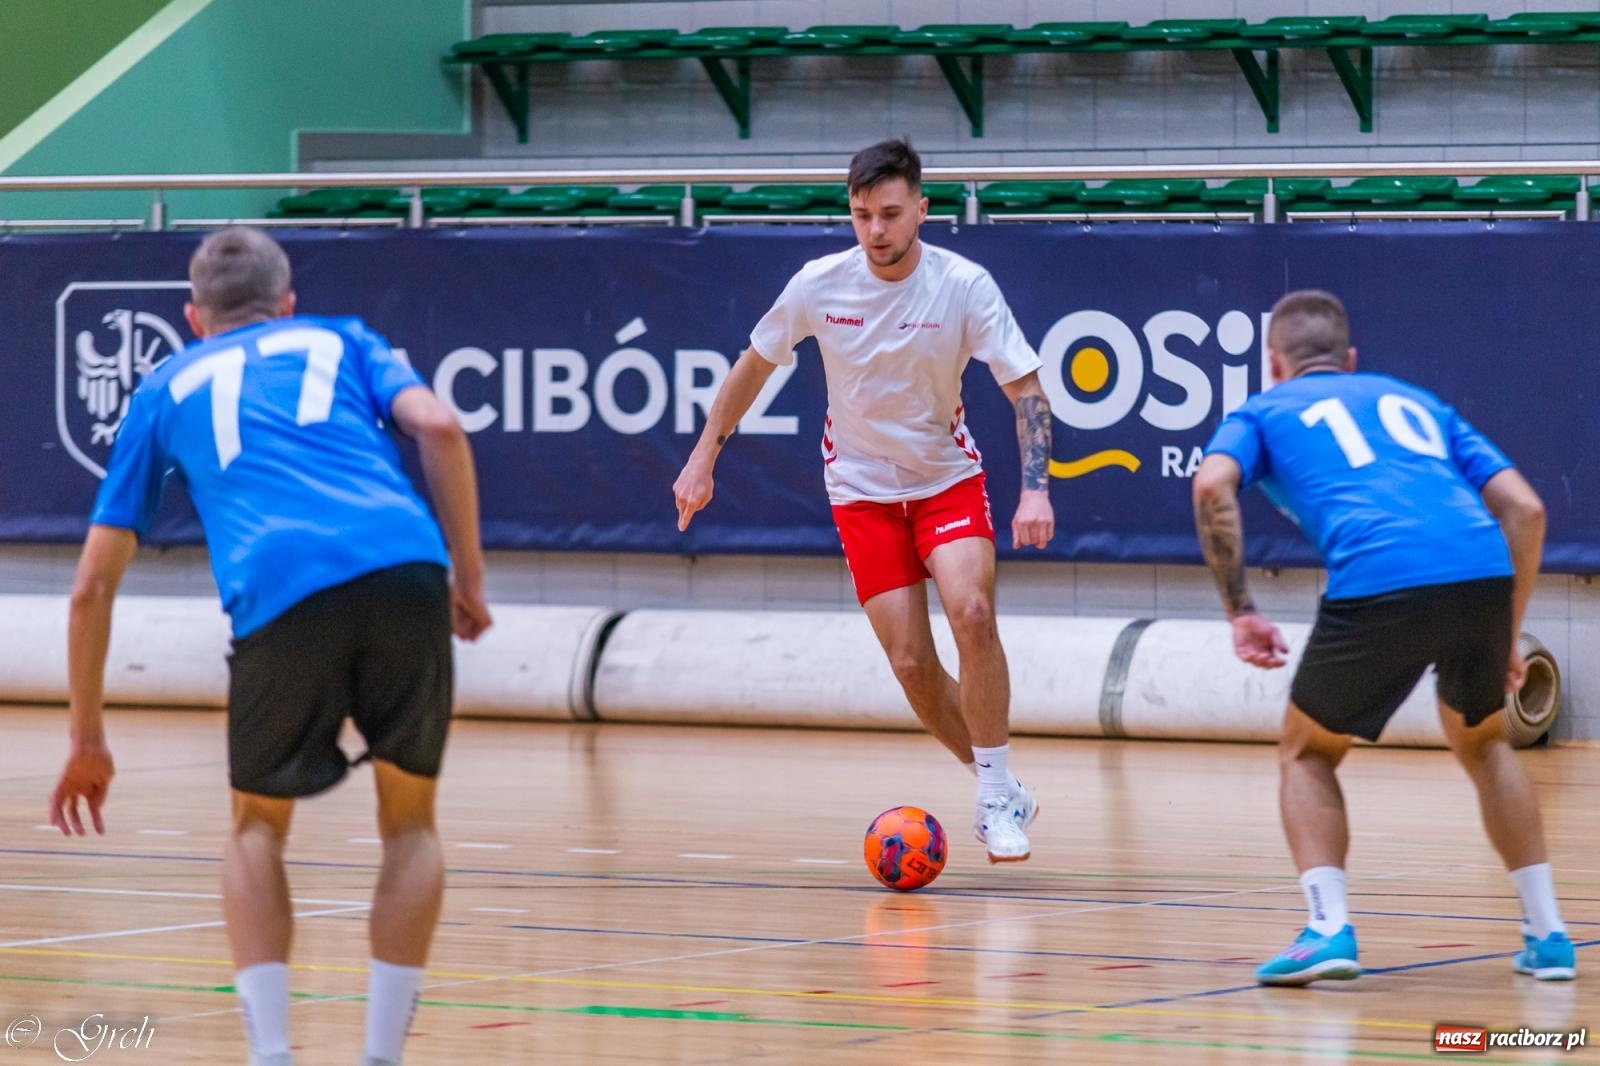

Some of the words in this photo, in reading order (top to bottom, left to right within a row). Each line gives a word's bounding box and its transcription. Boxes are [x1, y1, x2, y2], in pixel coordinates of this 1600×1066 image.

[826, 313, 864, 327] hummel
[169, 327, 344, 471] 77
[391, 316, 799, 435] CIBÓRZ
[1038, 309, 1272, 431] OSi
[1299, 393, 1448, 469] 10
[935, 516, 971, 536] hummel
[906, 857, 941, 880] ELECT
